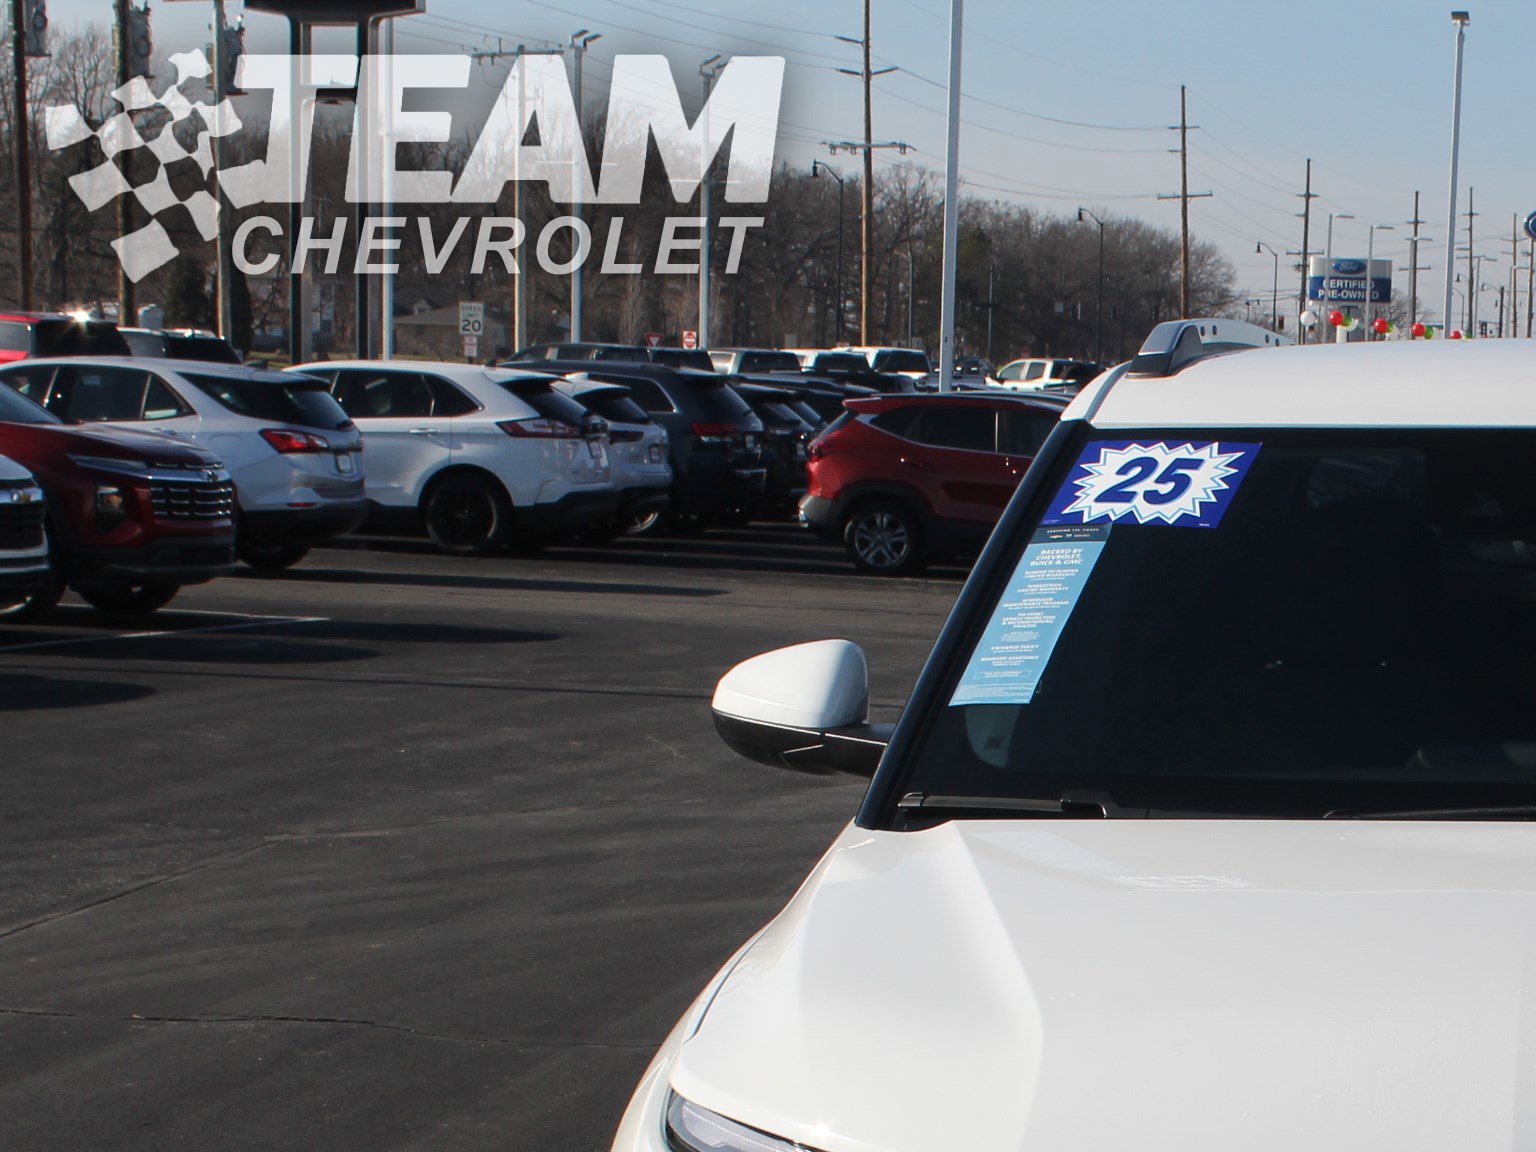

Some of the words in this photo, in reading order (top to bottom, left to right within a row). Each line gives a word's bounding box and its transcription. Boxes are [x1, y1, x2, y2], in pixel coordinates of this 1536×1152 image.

[1318, 289, 1379, 300] PE-OWND
[462, 319, 482, 332] 20
[1093, 457, 1204, 505] 25
